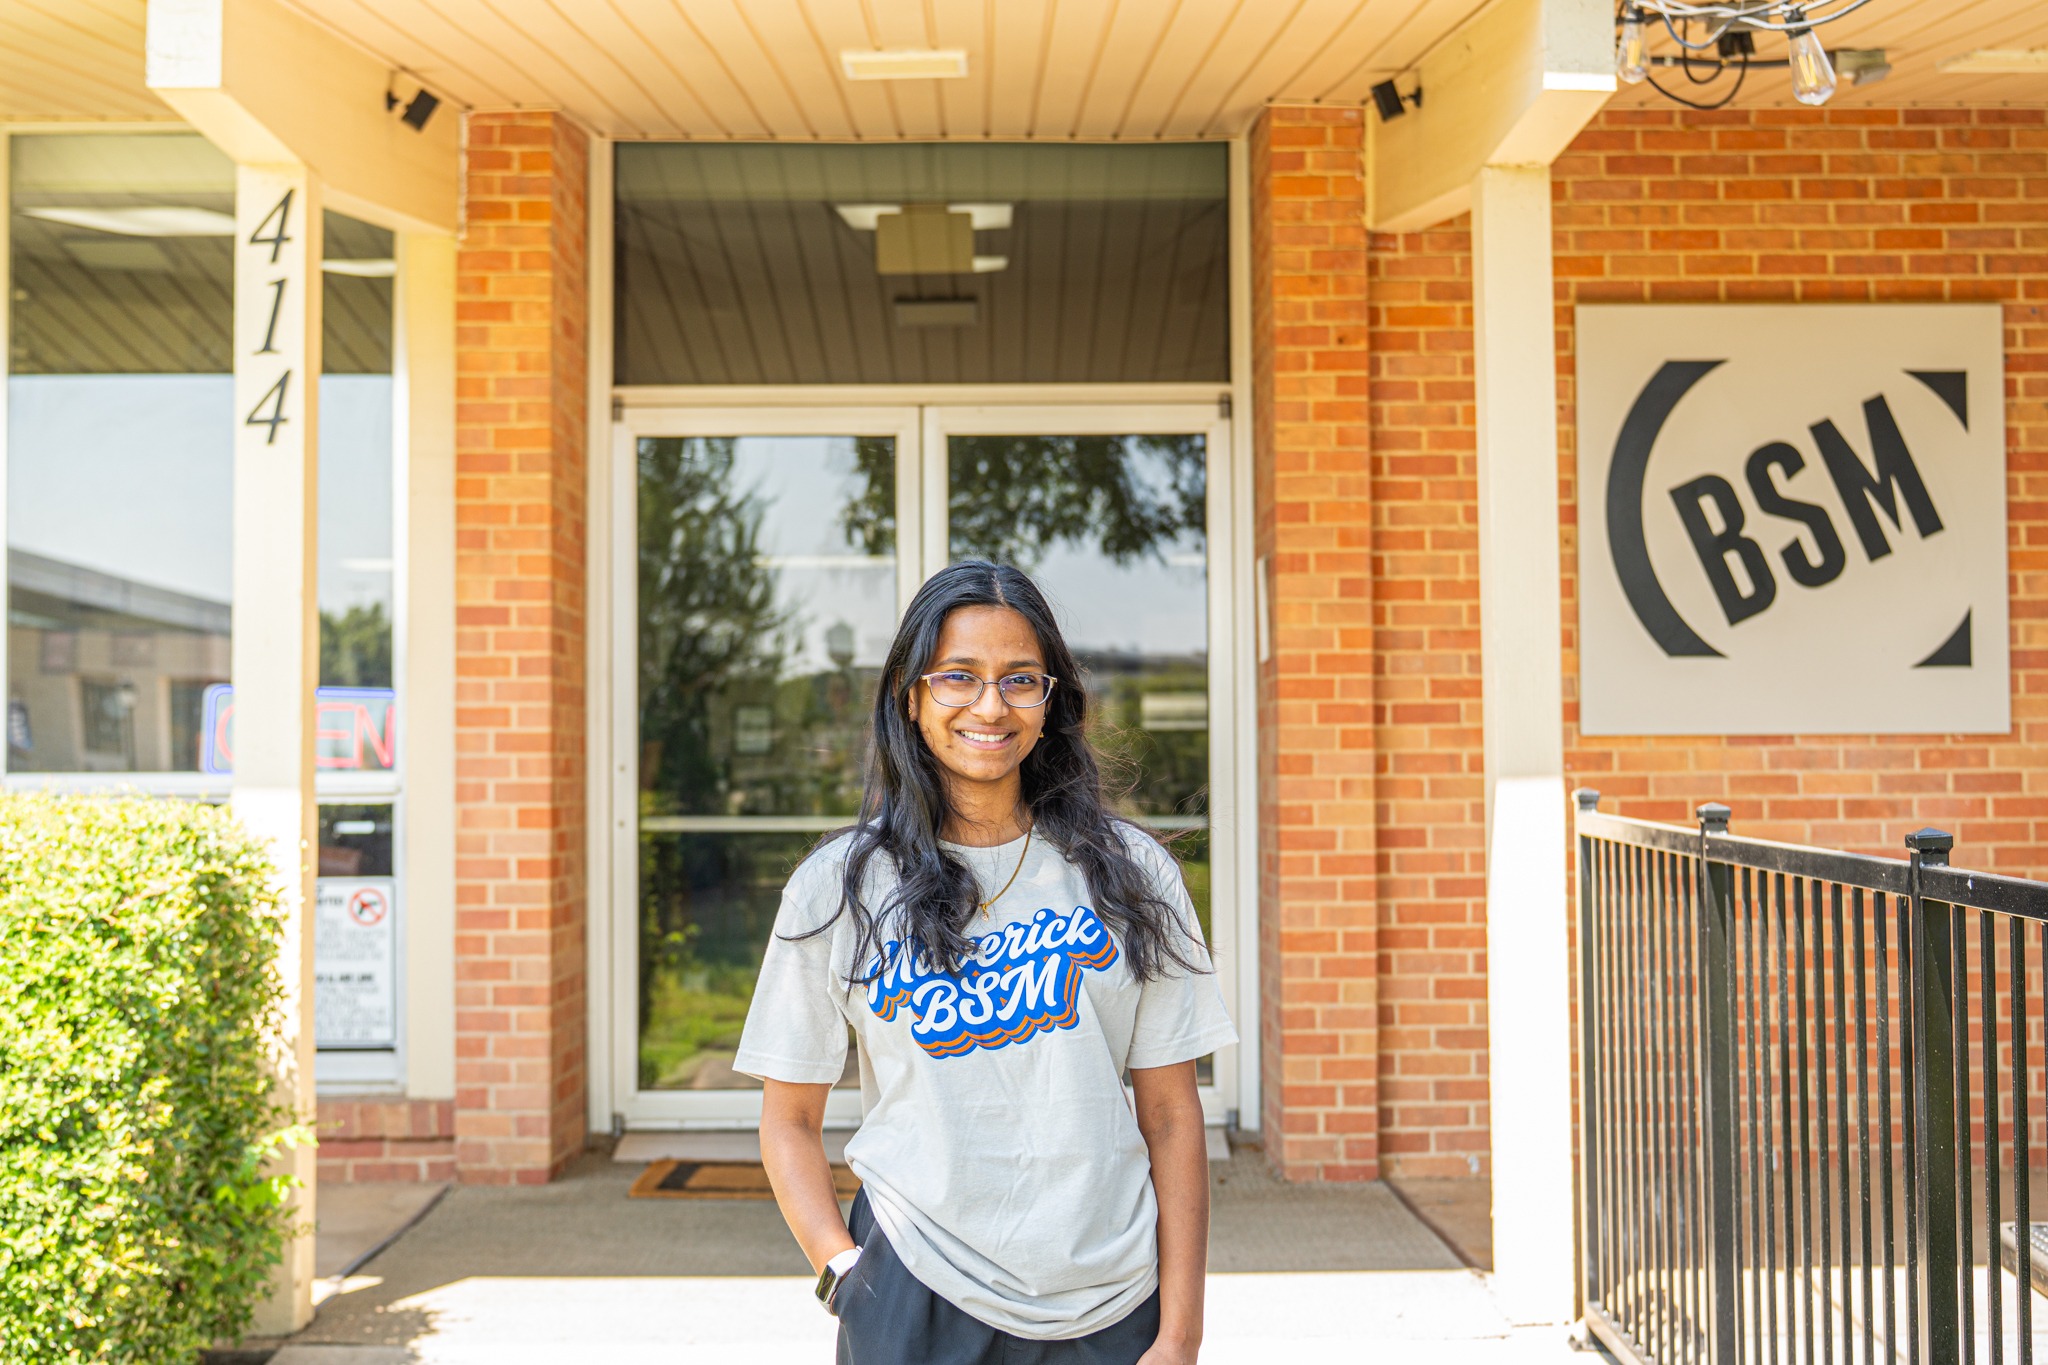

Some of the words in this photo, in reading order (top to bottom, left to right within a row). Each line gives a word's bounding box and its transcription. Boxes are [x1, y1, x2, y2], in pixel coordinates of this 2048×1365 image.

[244, 186, 297, 447] 414
[1668, 392, 1945, 627] BSM
[216, 701, 396, 768] EN
[912, 953, 1061, 1035] BSM
